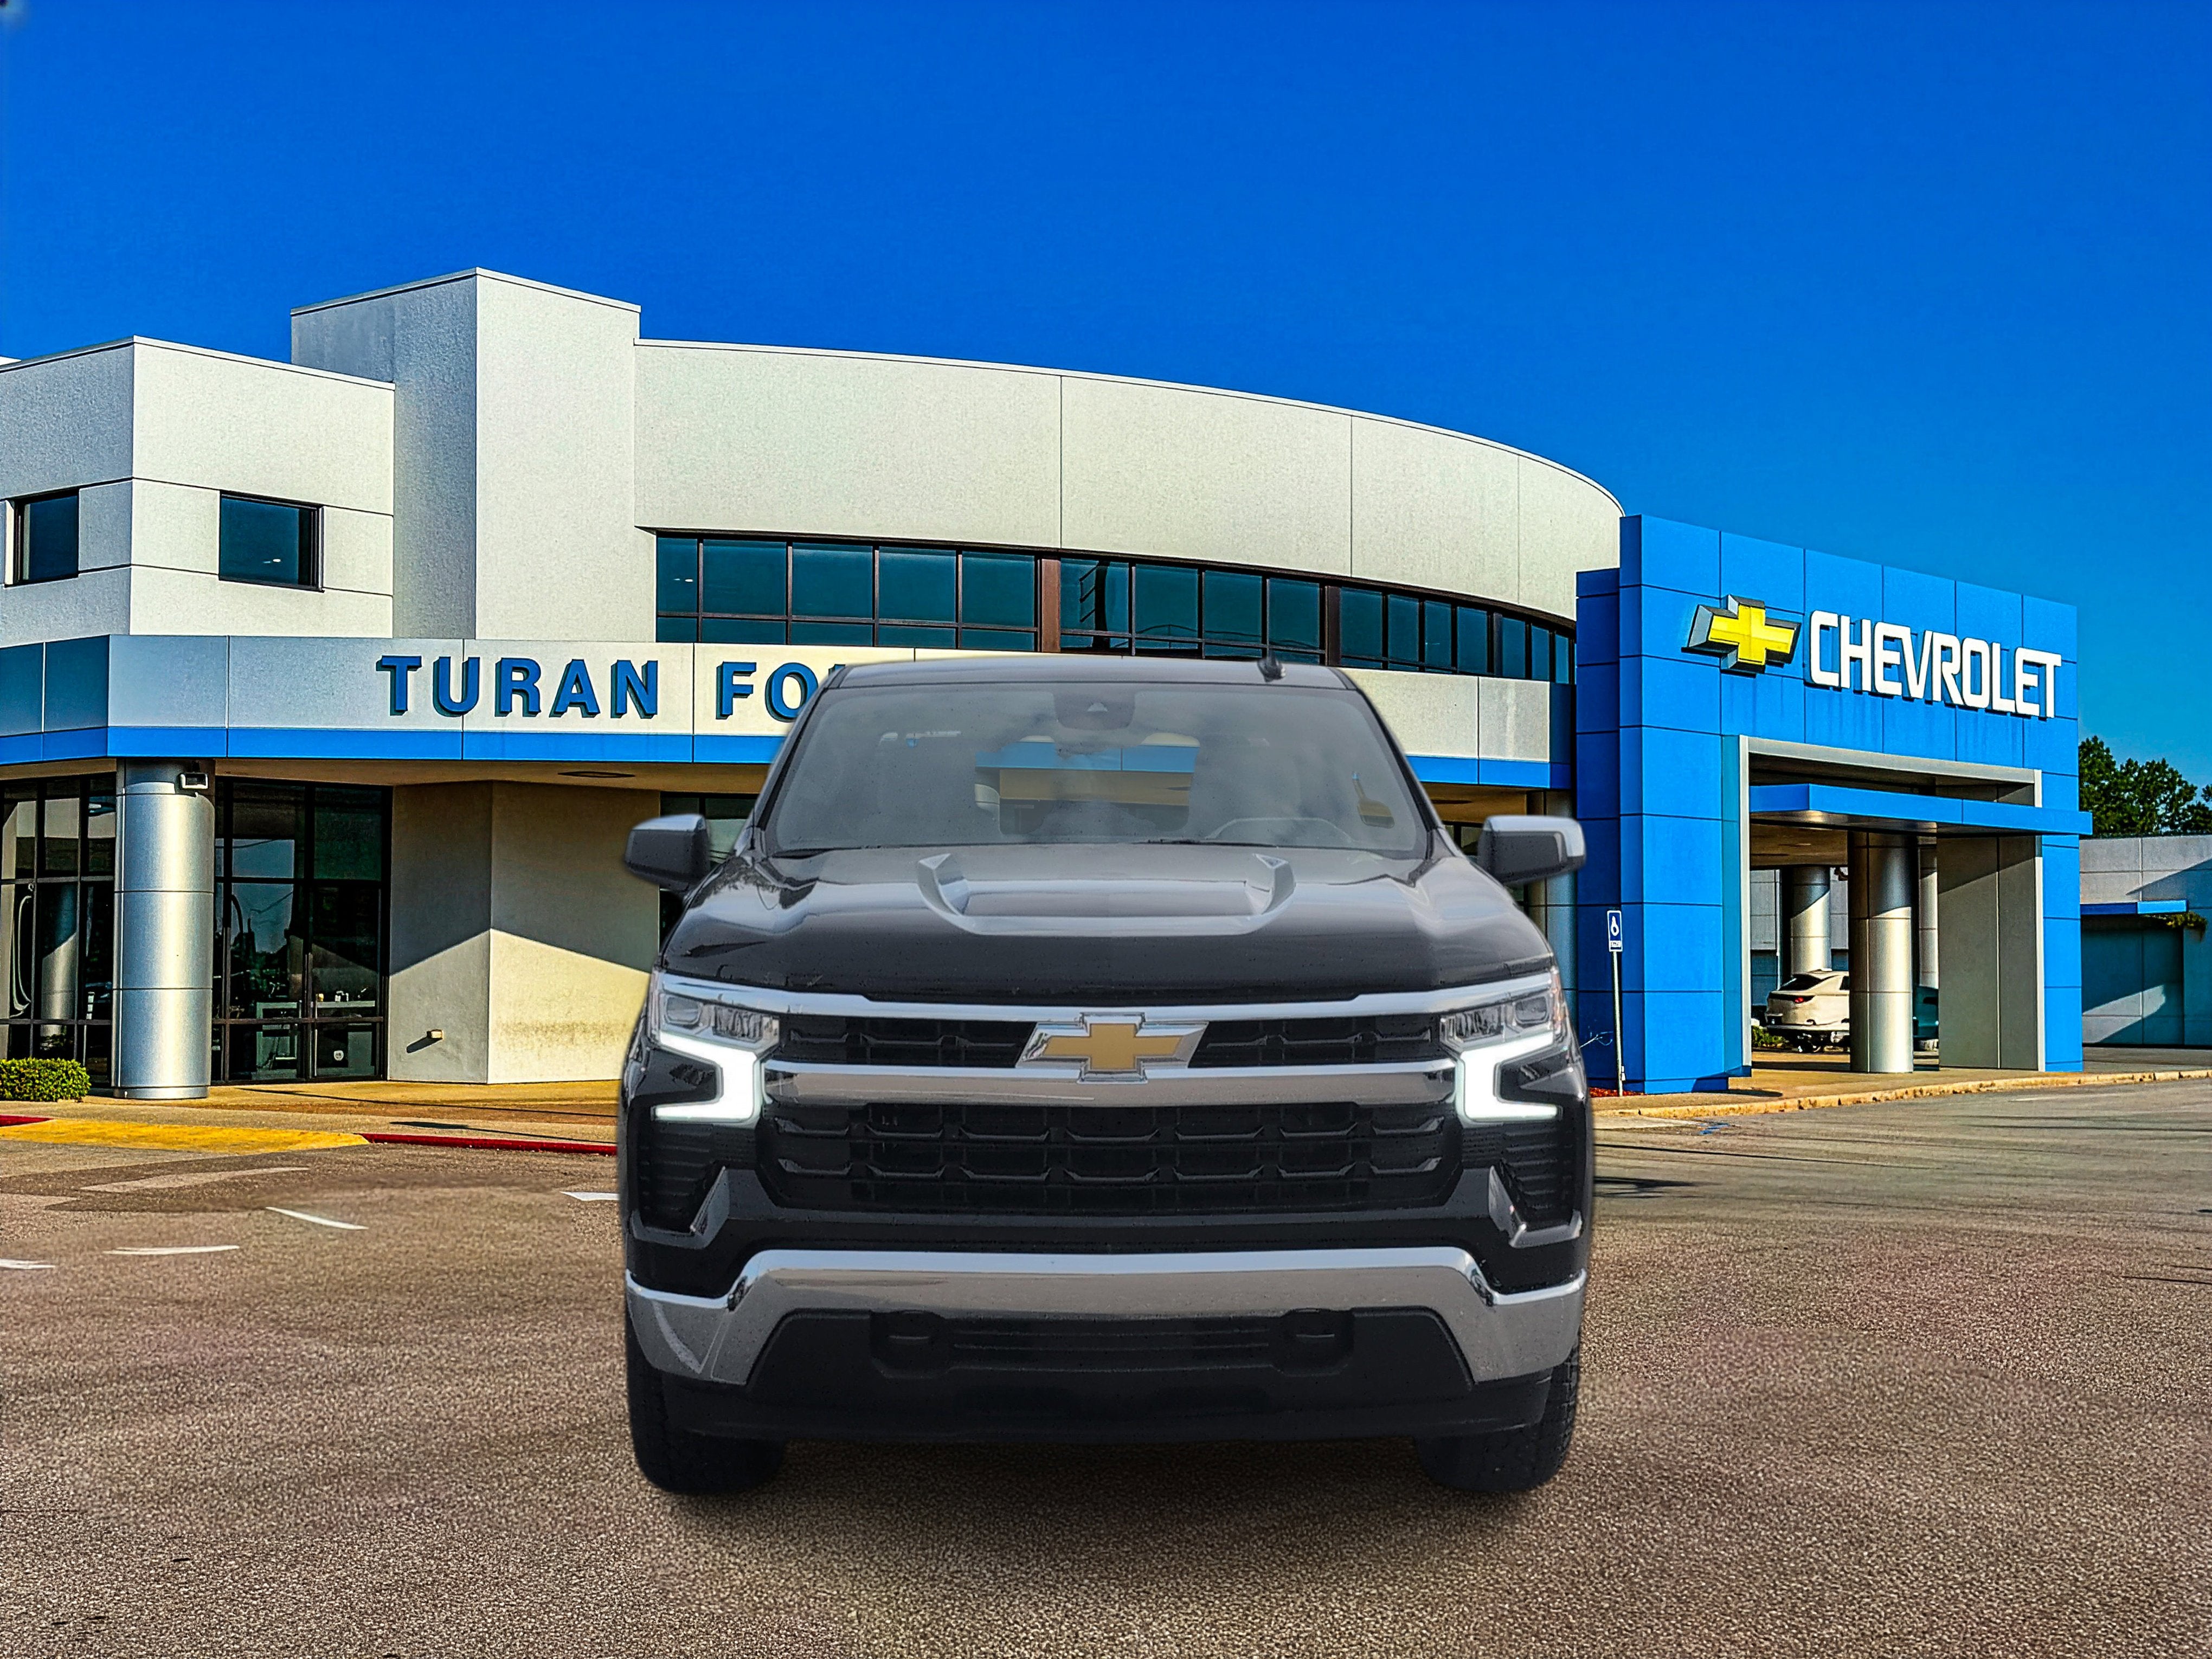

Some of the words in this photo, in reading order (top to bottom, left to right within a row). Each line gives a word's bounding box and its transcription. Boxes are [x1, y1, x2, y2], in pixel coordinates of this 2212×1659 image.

[376, 655, 658, 719] TURAN
[716, 661, 846, 723] FO
[1810, 610, 2062, 719] CHEVROLET
